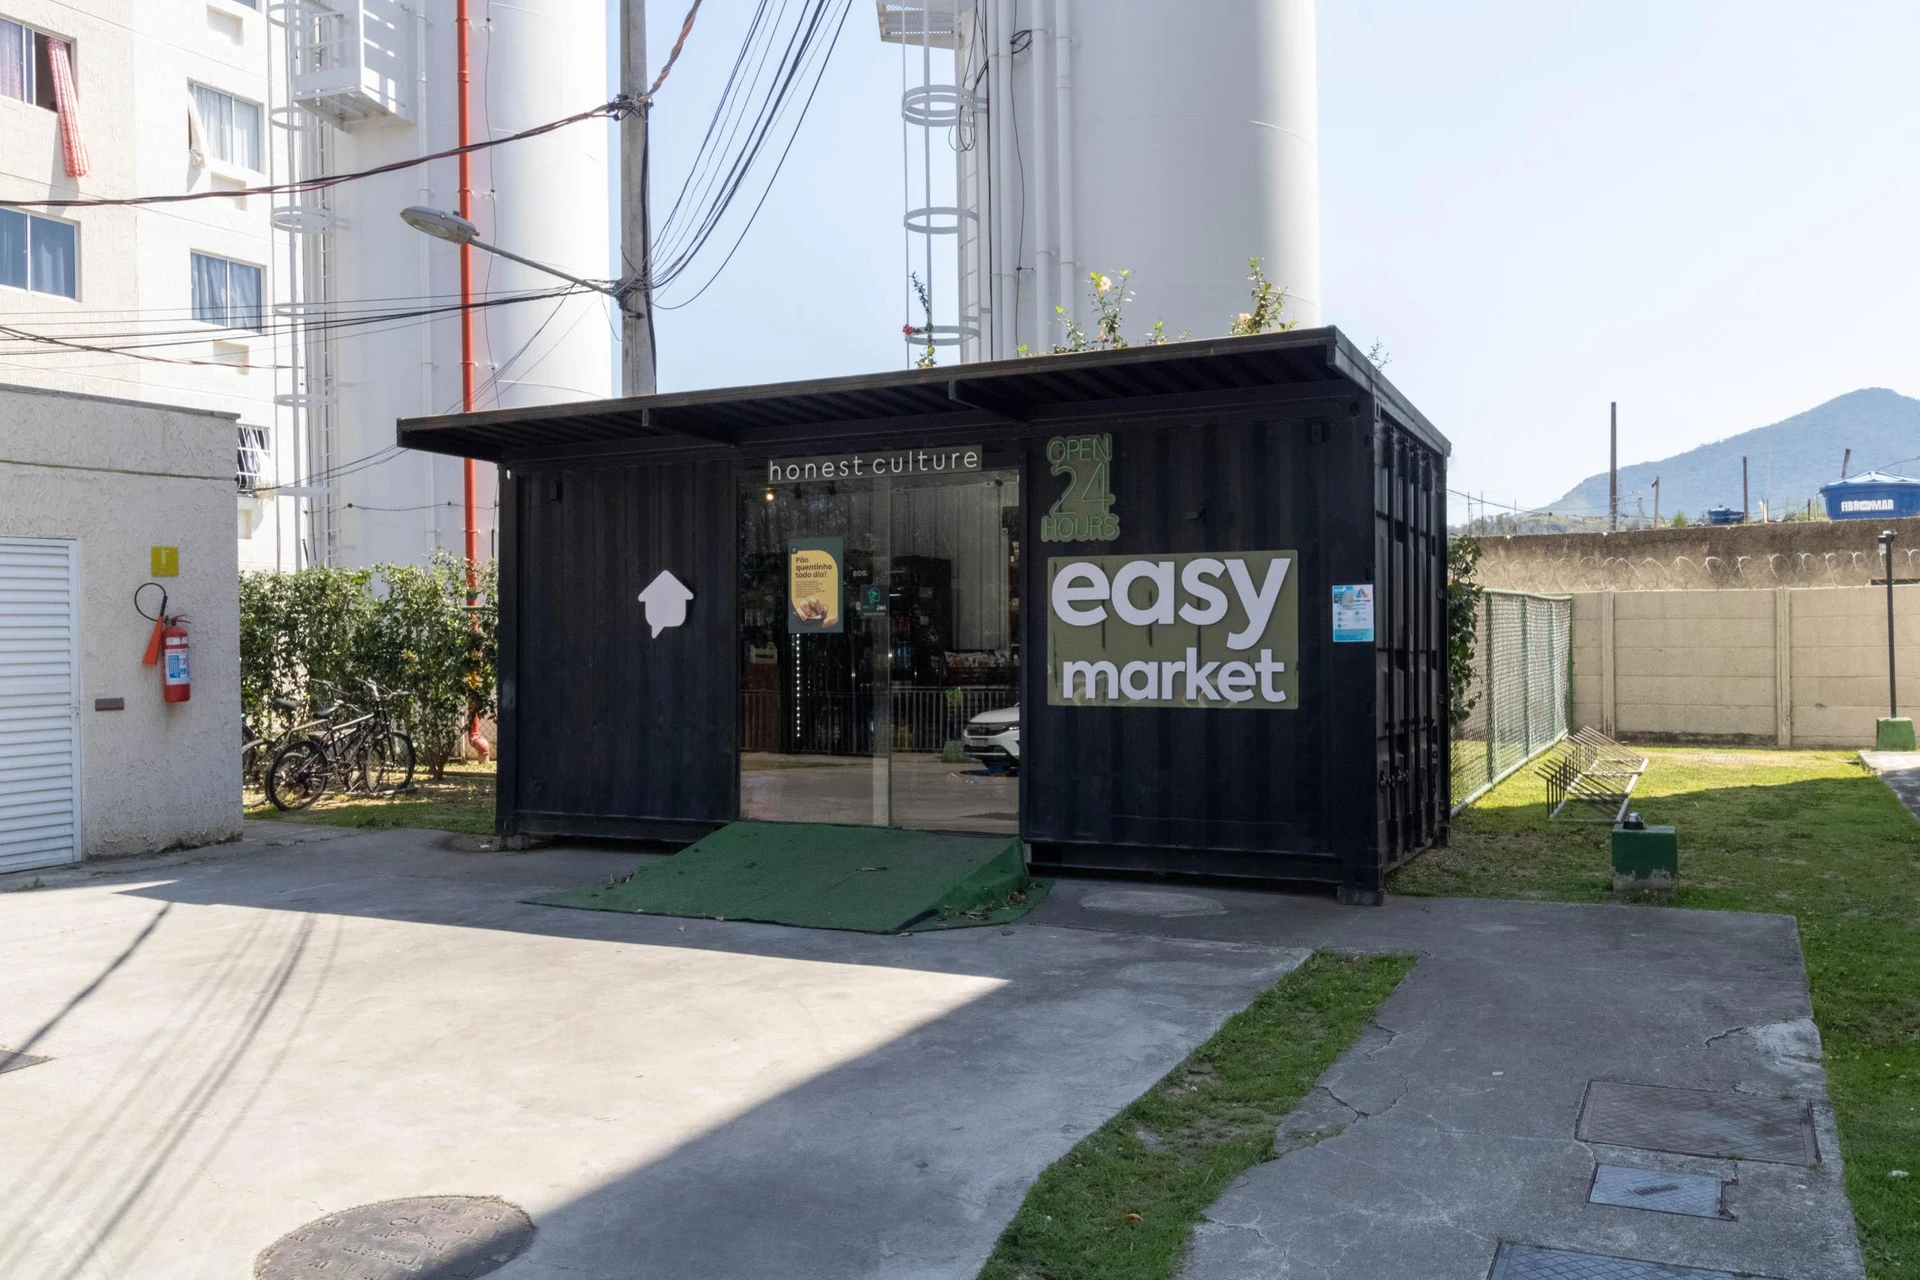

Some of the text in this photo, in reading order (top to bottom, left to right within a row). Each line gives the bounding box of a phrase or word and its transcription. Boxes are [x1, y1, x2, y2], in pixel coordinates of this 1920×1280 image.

[1049, 436, 1109, 461] OPEN
[769, 450, 978, 481] honest culture
[1051, 461, 1111, 515] 24
[1044, 516, 1117, 538] HOURS
[795, 563, 832, 572] quentinho
[1051, 557, 1292, 651] easy
[1062, 646, 1287, 703] market
